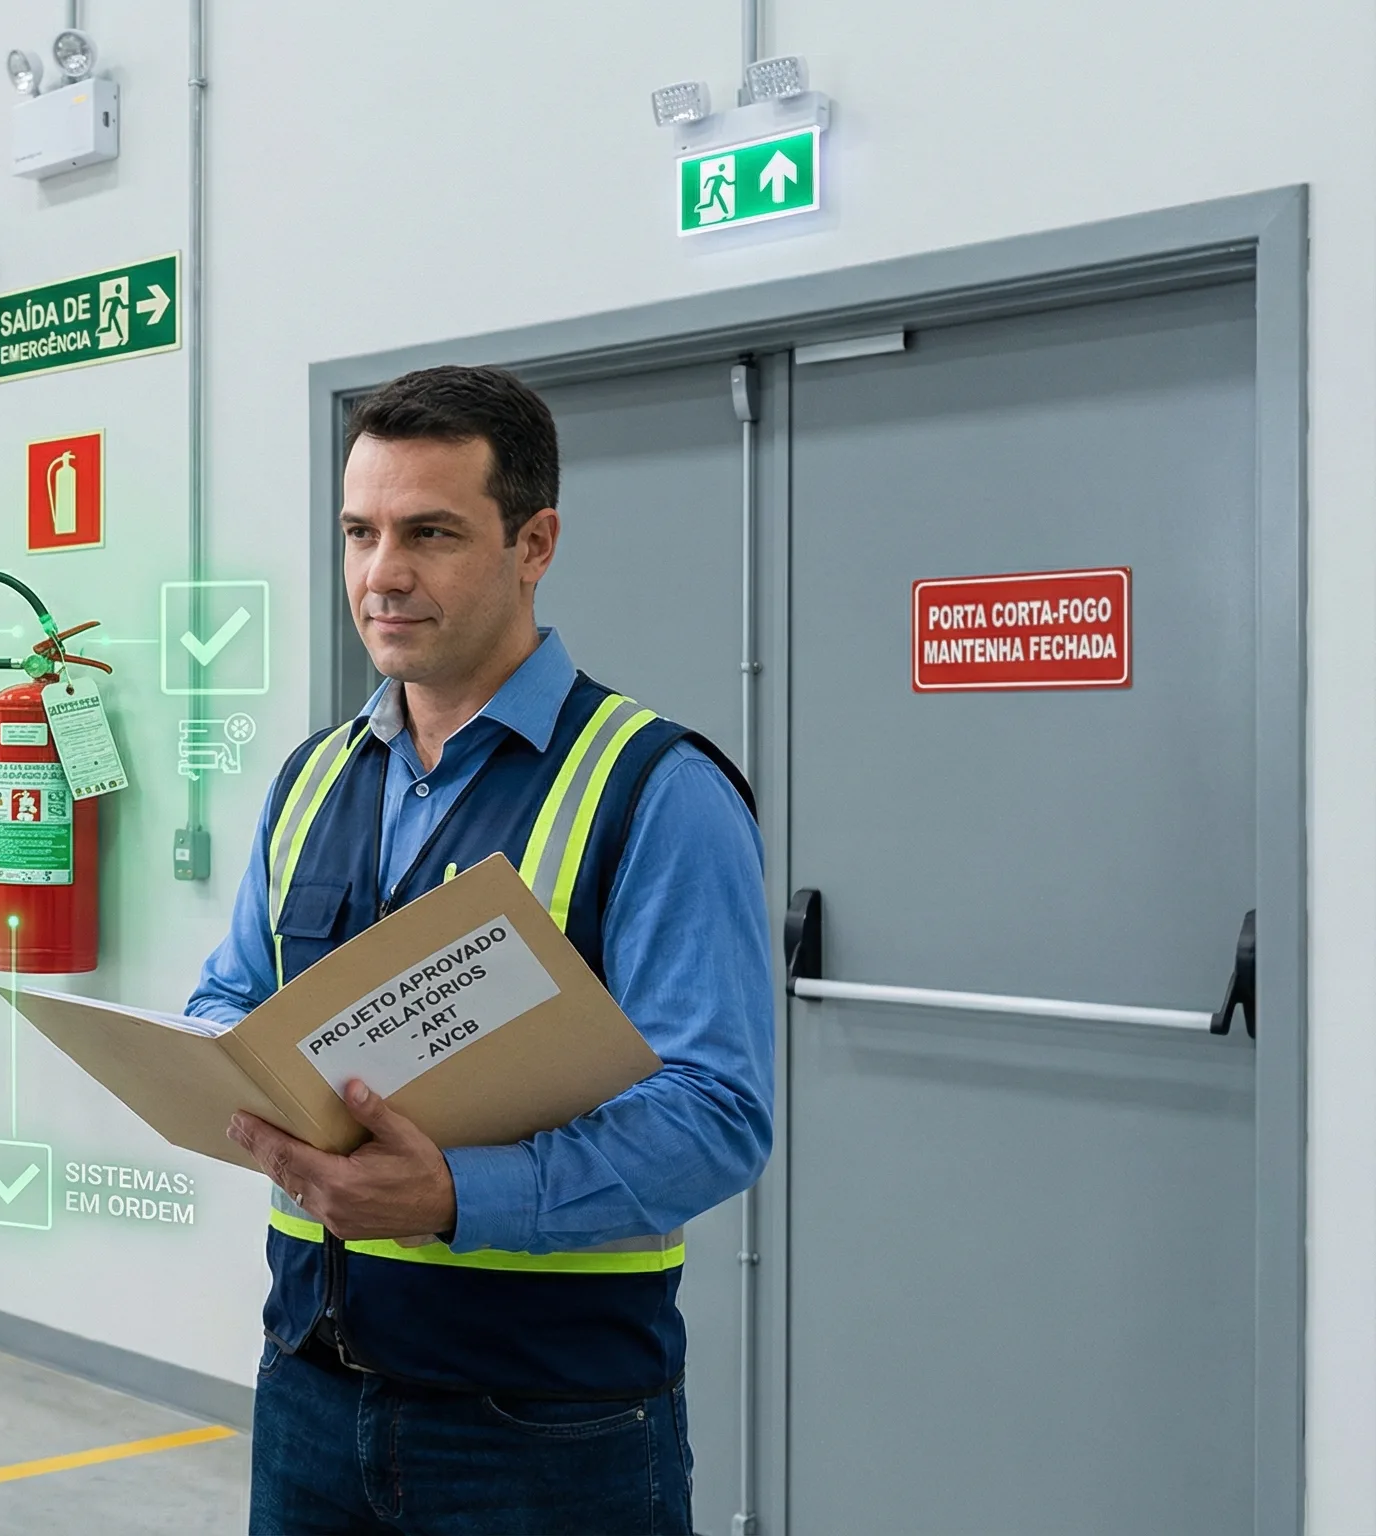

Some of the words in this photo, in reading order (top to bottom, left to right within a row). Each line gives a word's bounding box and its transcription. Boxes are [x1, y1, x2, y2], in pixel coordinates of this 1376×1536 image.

[0, 299, 59, 336] SAÍDA
[63, 293, 91, 323] DE
[0, 330, 91, 364] EMERGÊNCIA
[928, 603, 987, 630] PORTA
[991, 597, 1112, 627] CORTA-FOGO
[924, 637, 1024, 664] MANTENHA
[1029, 633, 1117, 661] FECHADA
[308, 991, 397, 1055] PROJETO
[398, 926, 507, 998] APROVADO
[366, 964, 487, 1044] RELATÓRIOS
[421, 1003, 459, 1038] ART
[428, 1018, 480, 1058] AVCB
